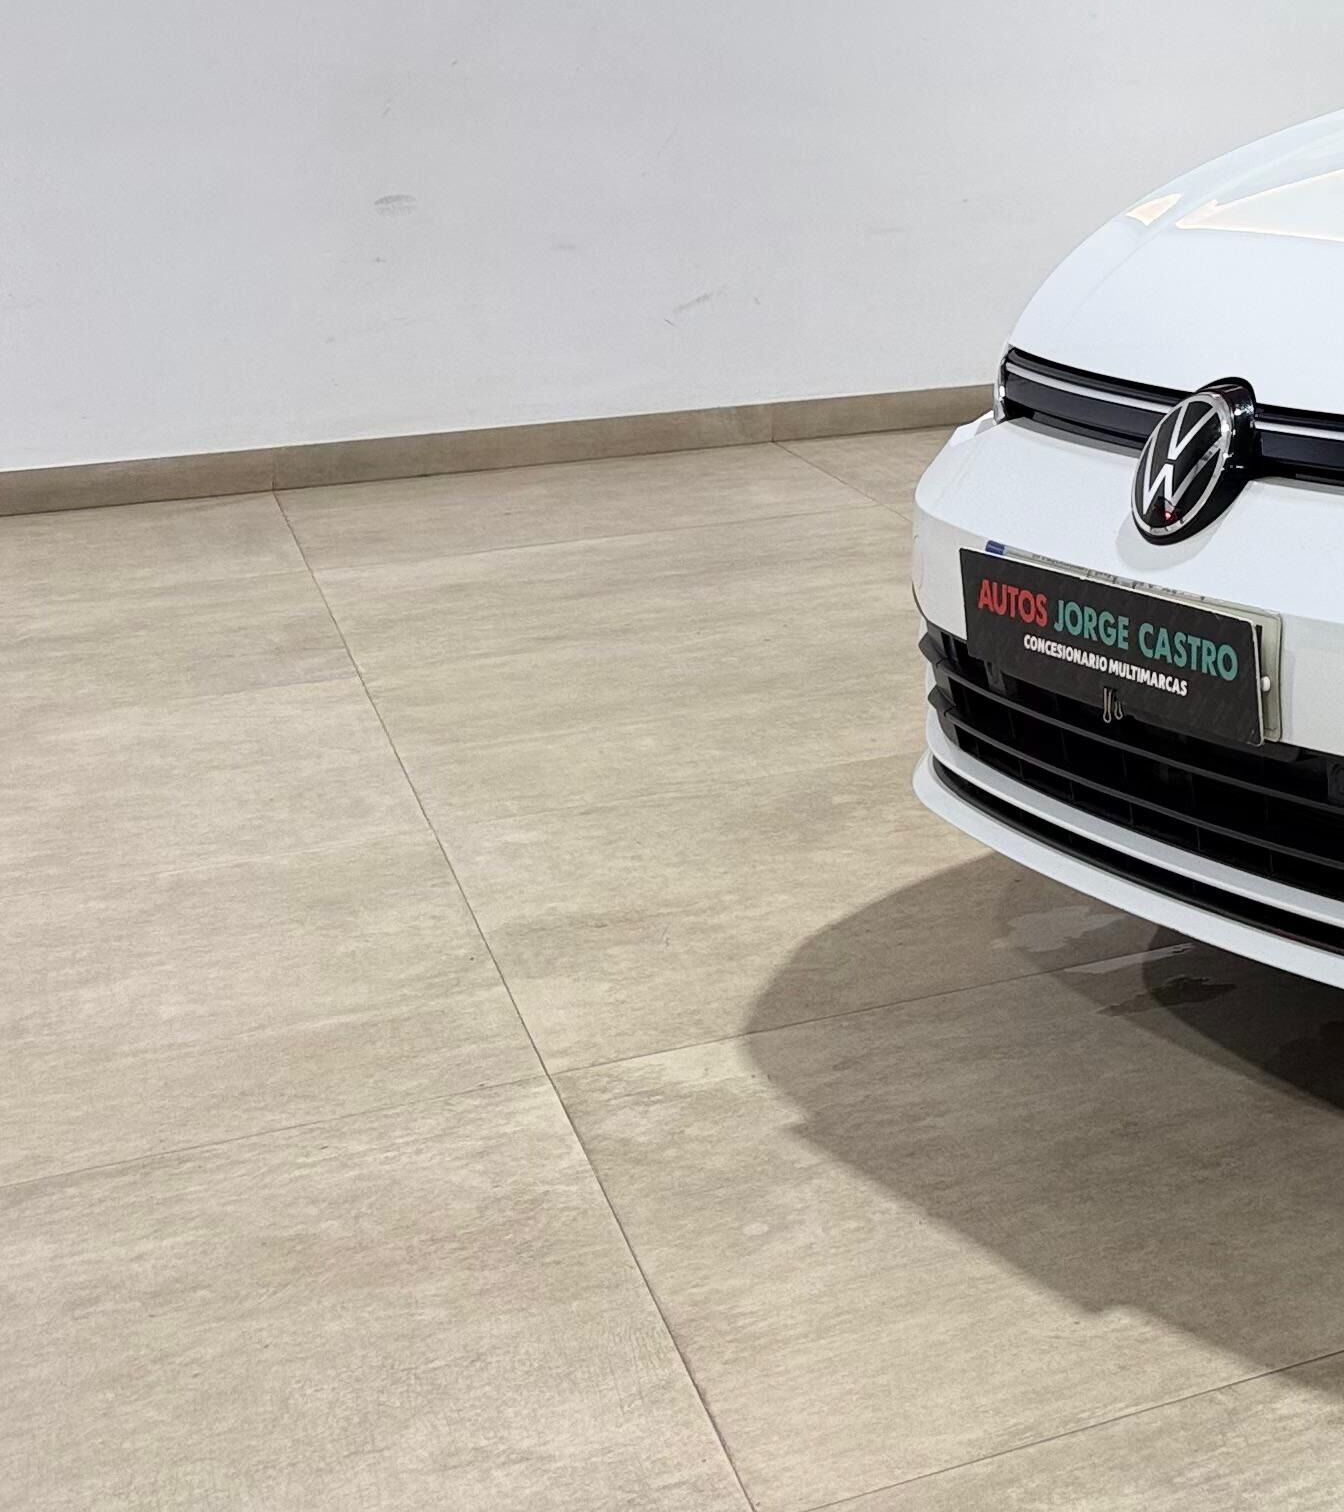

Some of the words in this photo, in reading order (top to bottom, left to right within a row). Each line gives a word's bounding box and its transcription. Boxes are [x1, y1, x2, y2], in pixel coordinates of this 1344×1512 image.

[978, 579, 1048, 627] AUTOS
[1054, 599, 1129, 650] JORGE
[1138, 622, 1238, 681] CASTRO
[1023, 634, 1108, 672] CONCESIONARIO
[1108, 658, 1188, 697] MULTIMARCAS
